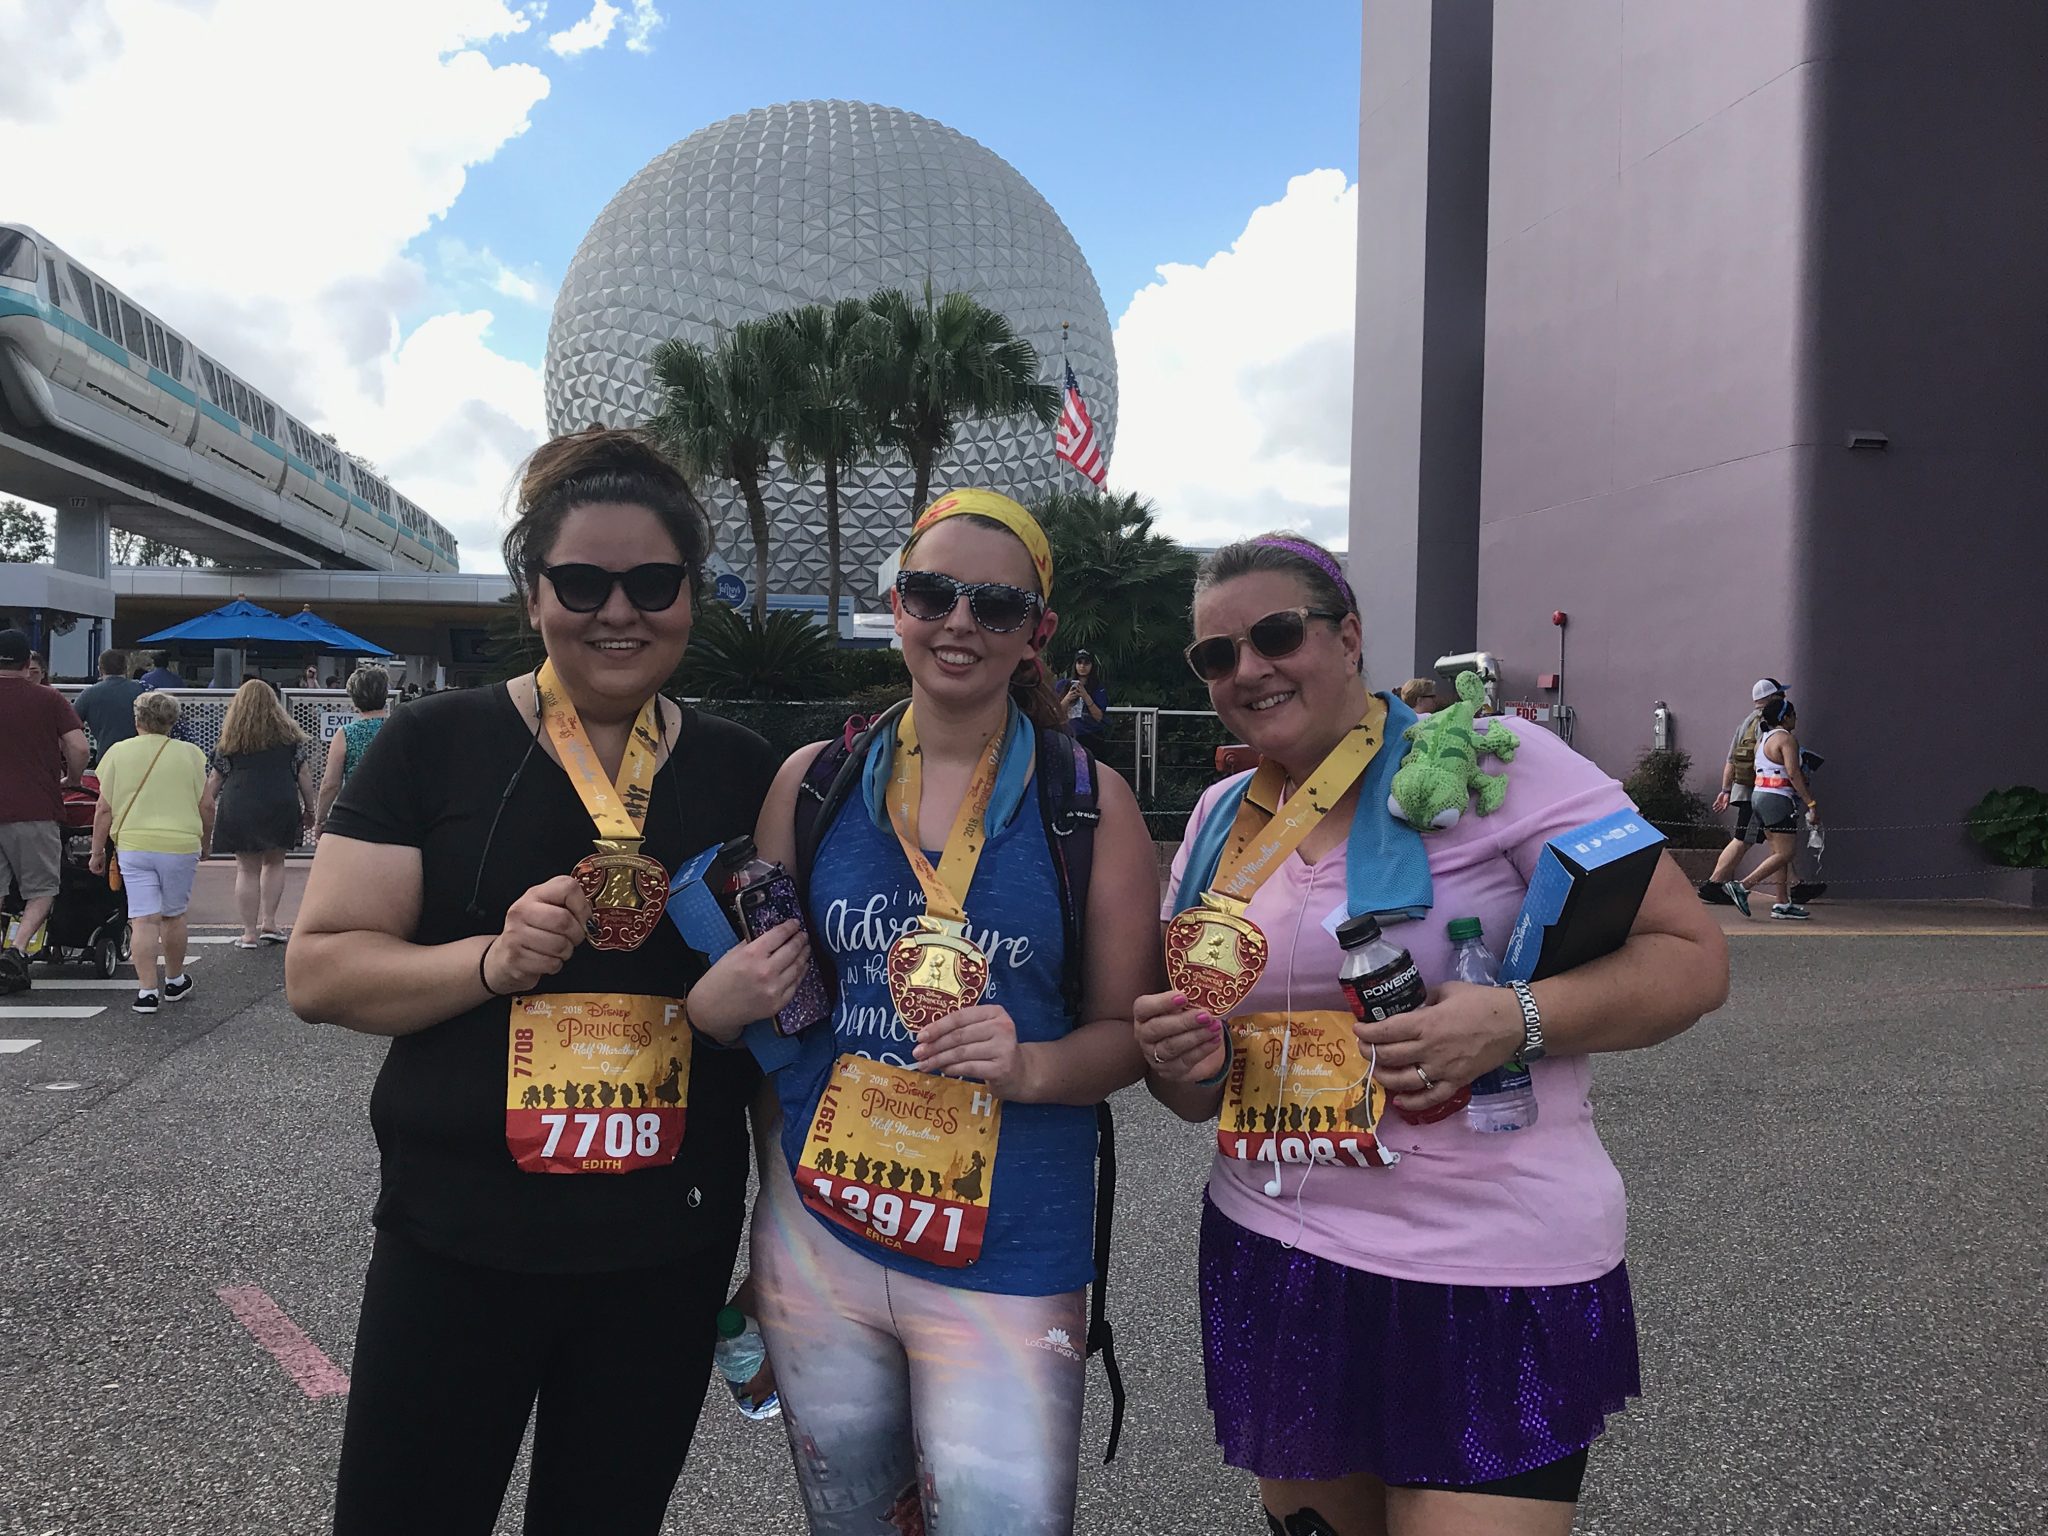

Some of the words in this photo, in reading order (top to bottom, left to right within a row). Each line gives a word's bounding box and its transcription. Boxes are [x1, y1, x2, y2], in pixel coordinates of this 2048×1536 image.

[71, 498, 86, 507] 177
[328, 716, 353, 726] EXIT
[964, 817, 979, 838] 2018
[1362, 964, 1418, 999] POWERAD
[562, 1006, 583, 1015] 2018
[664, 1004, 679, 1026] F
[556, 1018, 652, 1048] PRINCESS
[514, 1028, 534, 1078] 7708
[571, 1042, 597, 1059] Half
[597, 1041, 640, 1056] Marathon
[869, 1074, 890, 1087] 2018
[1229, 1048, 1248, 1108] 14981
[813, 1084, 842, 1143] 13971
[861, 1087, 959, 1134] PRINCESS
[970, 1091, 993, 1117] H
[540, 1113, 661, 1158] 7708
[870, 1116, 894, 1137] Half
[895, 1121, 941, 1143] Marathon
[581, 1159, 622, 1170] EDITH
[813, 1178, 964, 1253] 13971
[865, 1228, 902, 1249] ERICA
